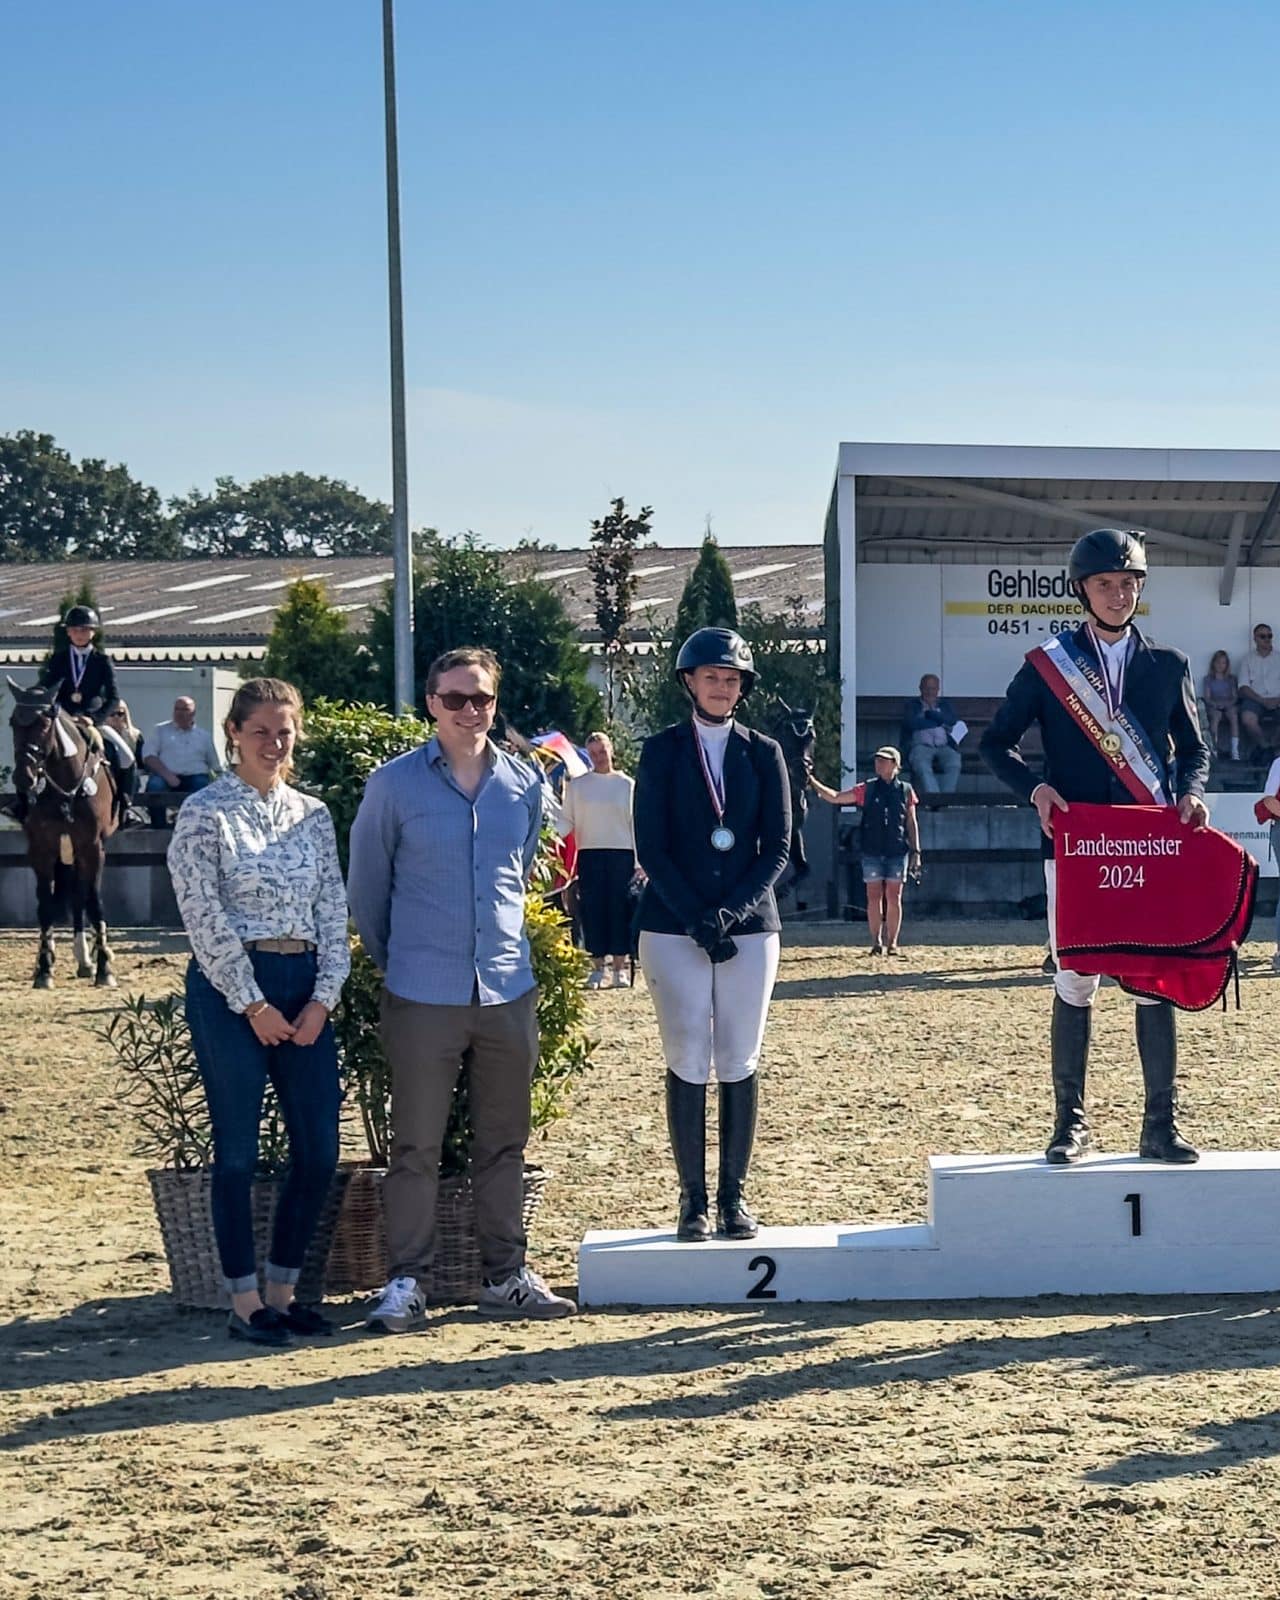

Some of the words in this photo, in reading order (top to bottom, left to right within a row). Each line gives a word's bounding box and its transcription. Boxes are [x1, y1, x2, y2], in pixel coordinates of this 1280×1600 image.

[988, 569, 1076, 598] Gehlsdo
[988, 604, 1014, 615] DER
[1021, 604, 1088, 615] DACHDEC
[988, 620, 1030, 635] 0451
[1066, 693, 1104, 740] Havekos
[1110, 752, 1126, 769] 24
[1064, 832, 1183, 856] Landesmeister
[1099, 865, 1144, 888] 2024
[1124, 1194, 1141, 1236] 1
[746, 1256, 777, 1299] 2
[508, 1288, 529, 1306] N
